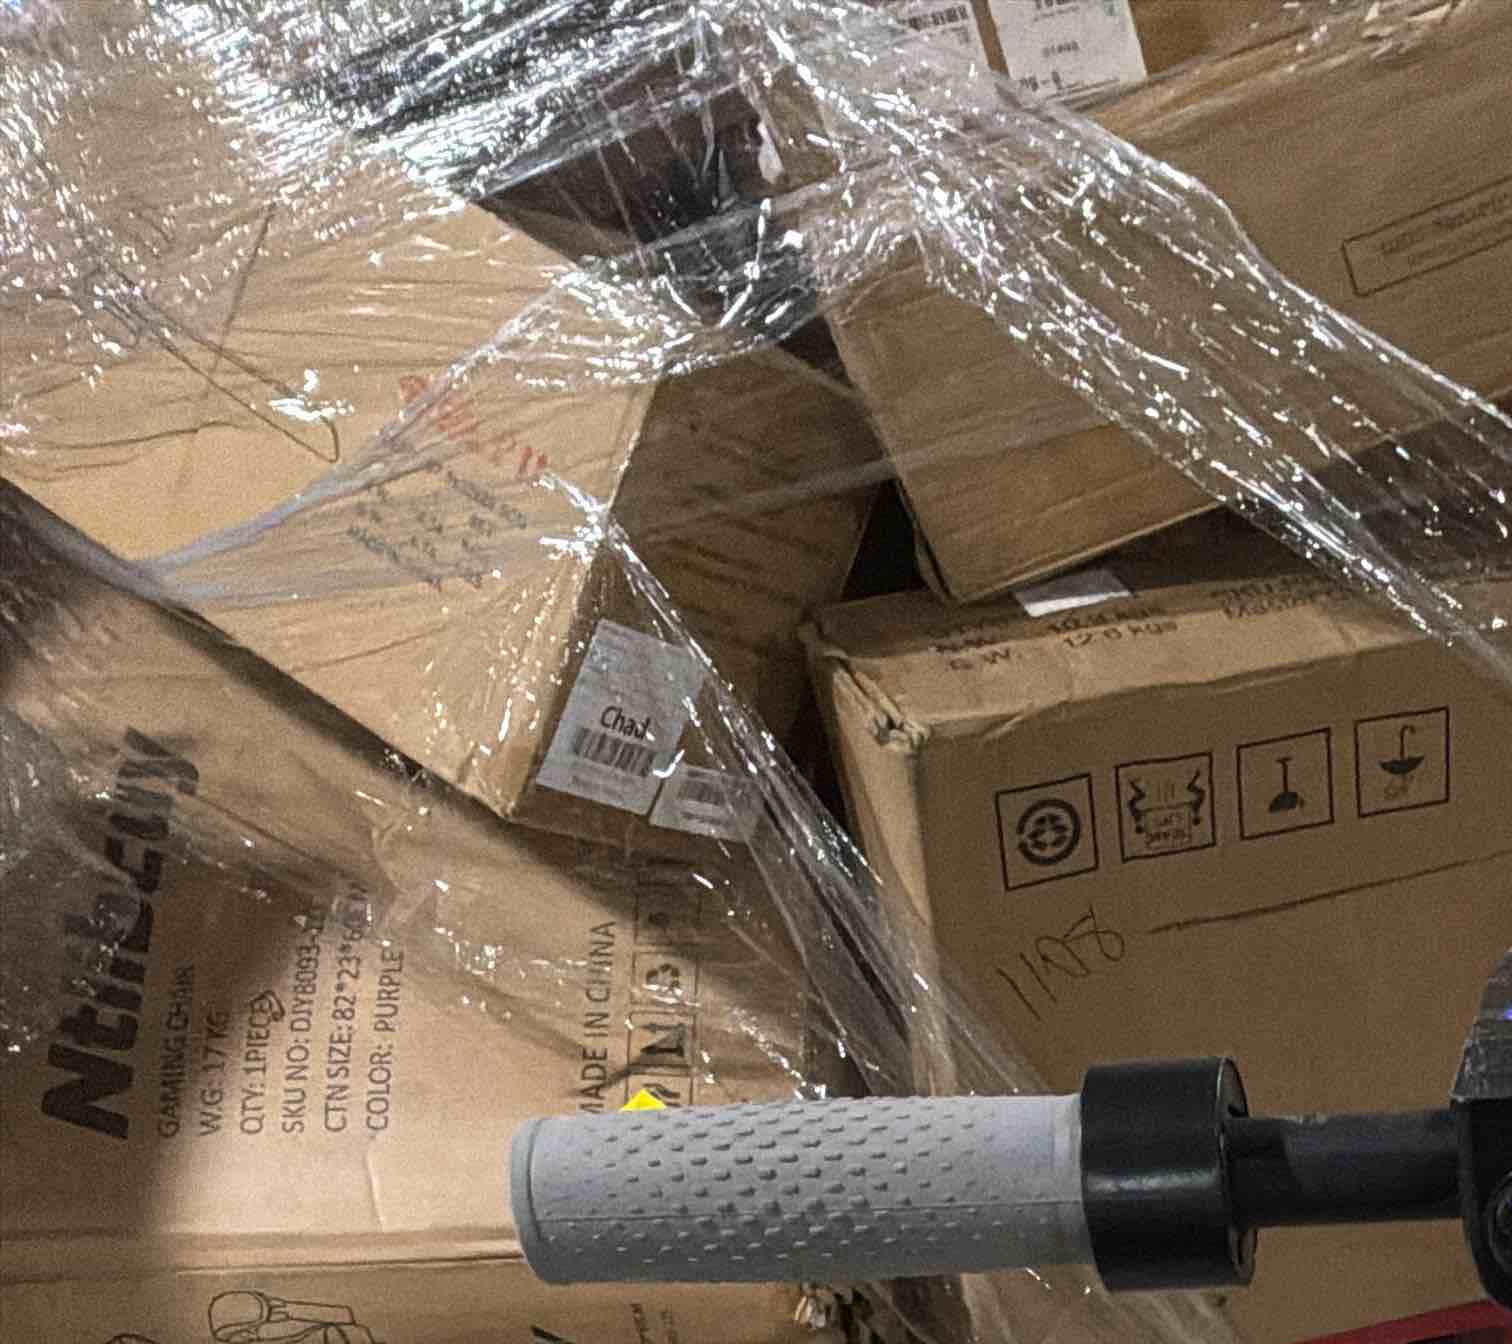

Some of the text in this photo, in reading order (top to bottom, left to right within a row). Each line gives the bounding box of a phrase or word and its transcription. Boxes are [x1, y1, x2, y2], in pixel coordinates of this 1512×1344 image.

[600, 705, 651, 739] Chad
[366, 944, 405, 1133] COLOR: PURPLE
[582, 1011, 610, 1038] IN
[285, 1037, 311, 1082] NO:
[239, 1082, 267, 1136] QTY:
[281, 1086, 307, 1135] SKU
[323, 1085, 351, 1133] CTN
